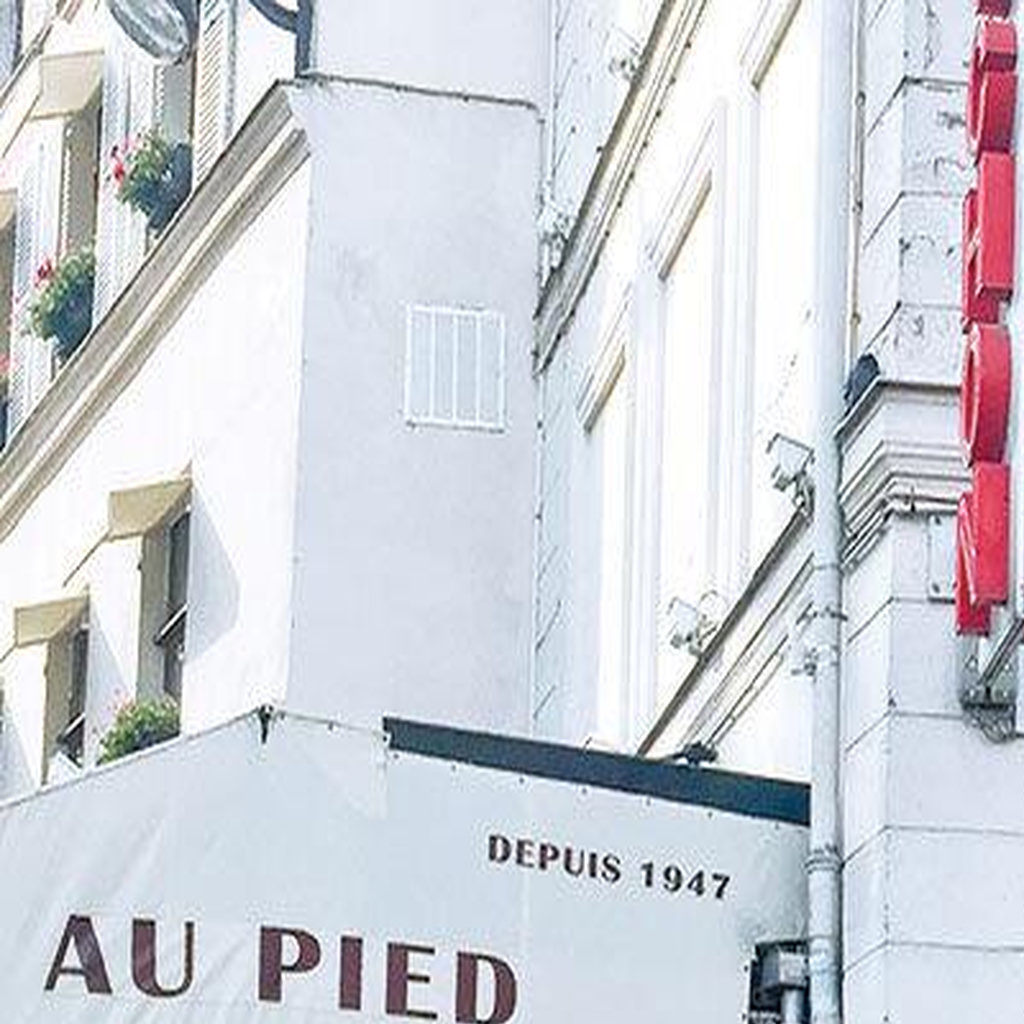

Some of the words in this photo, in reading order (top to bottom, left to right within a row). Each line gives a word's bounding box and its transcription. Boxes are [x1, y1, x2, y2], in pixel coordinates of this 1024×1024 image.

[488, 834, 622, 884] DEPUIS
[640, 861, 731, 899] 1947
[44, 913, 197, 998] AU
